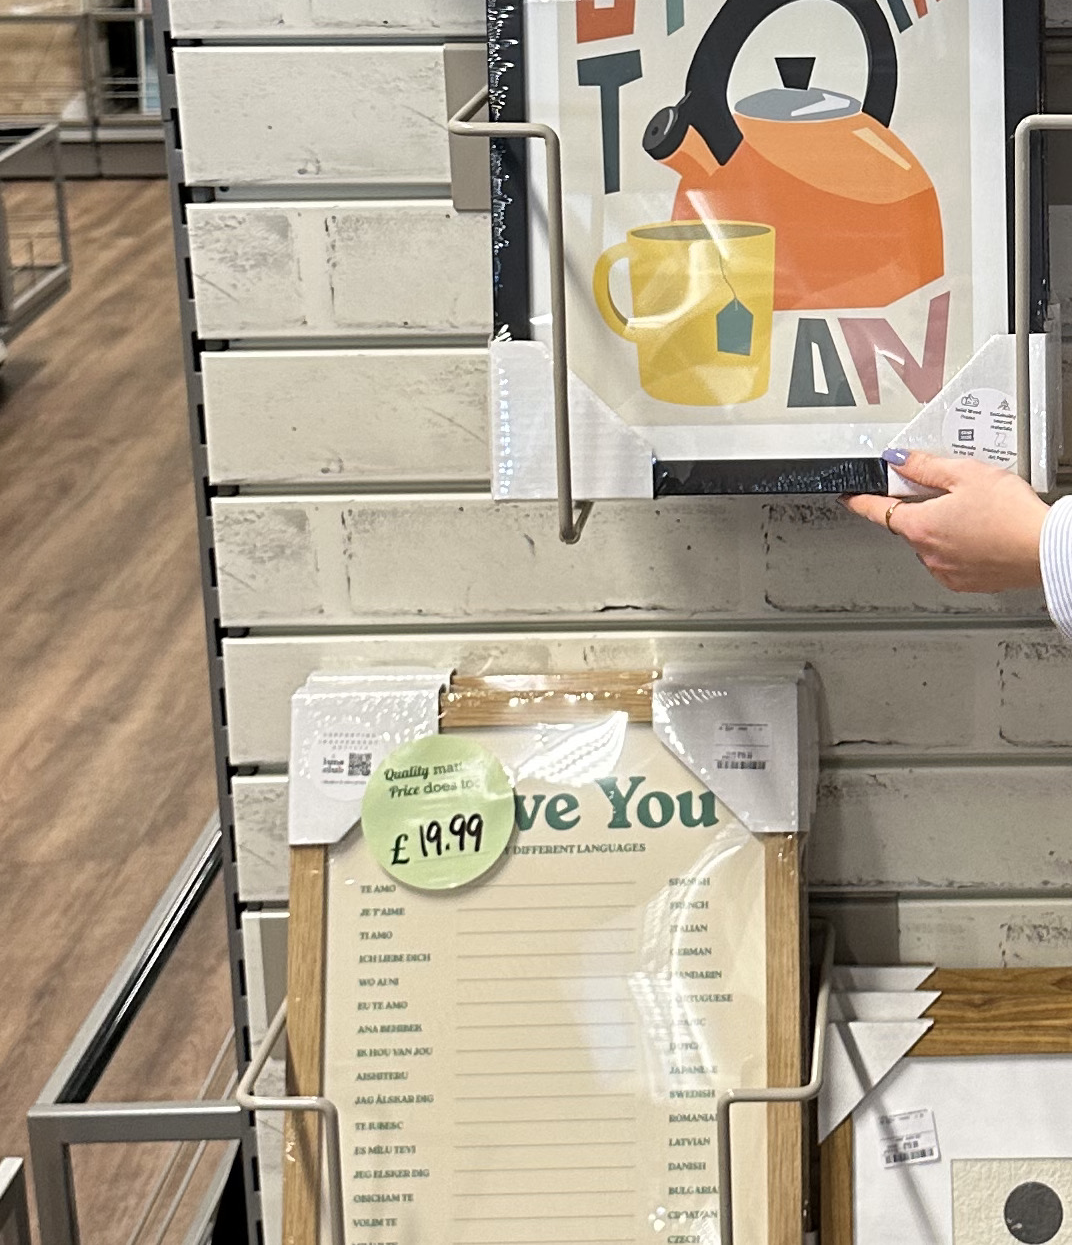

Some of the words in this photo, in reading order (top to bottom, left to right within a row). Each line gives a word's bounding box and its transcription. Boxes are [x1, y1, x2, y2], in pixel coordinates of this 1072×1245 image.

[384, 765, 430, 782] Quality
[389, 785, 420, 799] Price
[423, 781, 457, 795] does
[595, 775, 719, 829] You
[513, 844, 576, 855] DIFFERENT
[576, 842, 646, 854] LANGUAGES
[669, 1089, 716, 1099] SWEDISH
[668, 1137, 711, 1147] LATVIAN
[668, 1161, 707, 1171] DANISH
